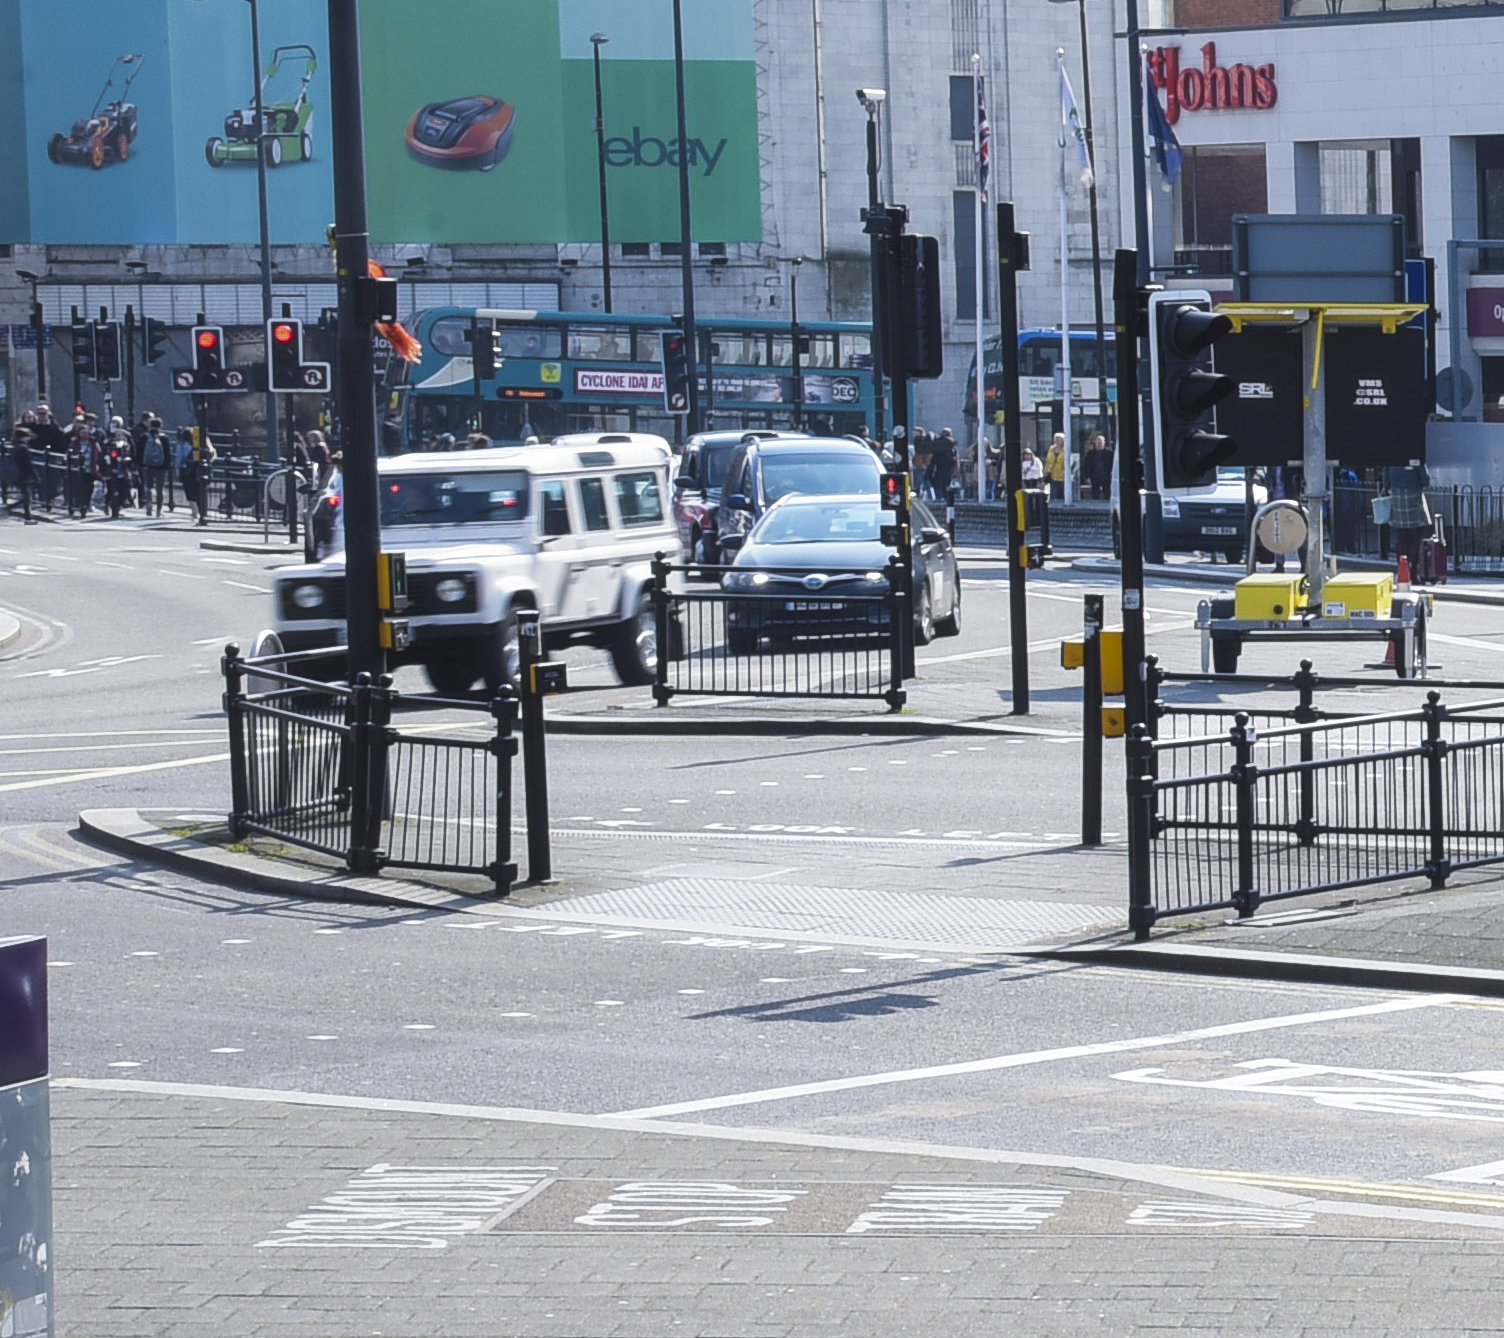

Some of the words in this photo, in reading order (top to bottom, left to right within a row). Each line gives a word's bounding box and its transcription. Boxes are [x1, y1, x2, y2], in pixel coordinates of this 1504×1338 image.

[1163, 41, 1278, 125] Johns
[603, 126, 729, 177] ebay
[581, 374, 625, 388] CYCLONE
[628, 376, 648, 389] IDAI
[1239, 383, 1272, 394] SRL
[832, 387, 857, 397] DEC
